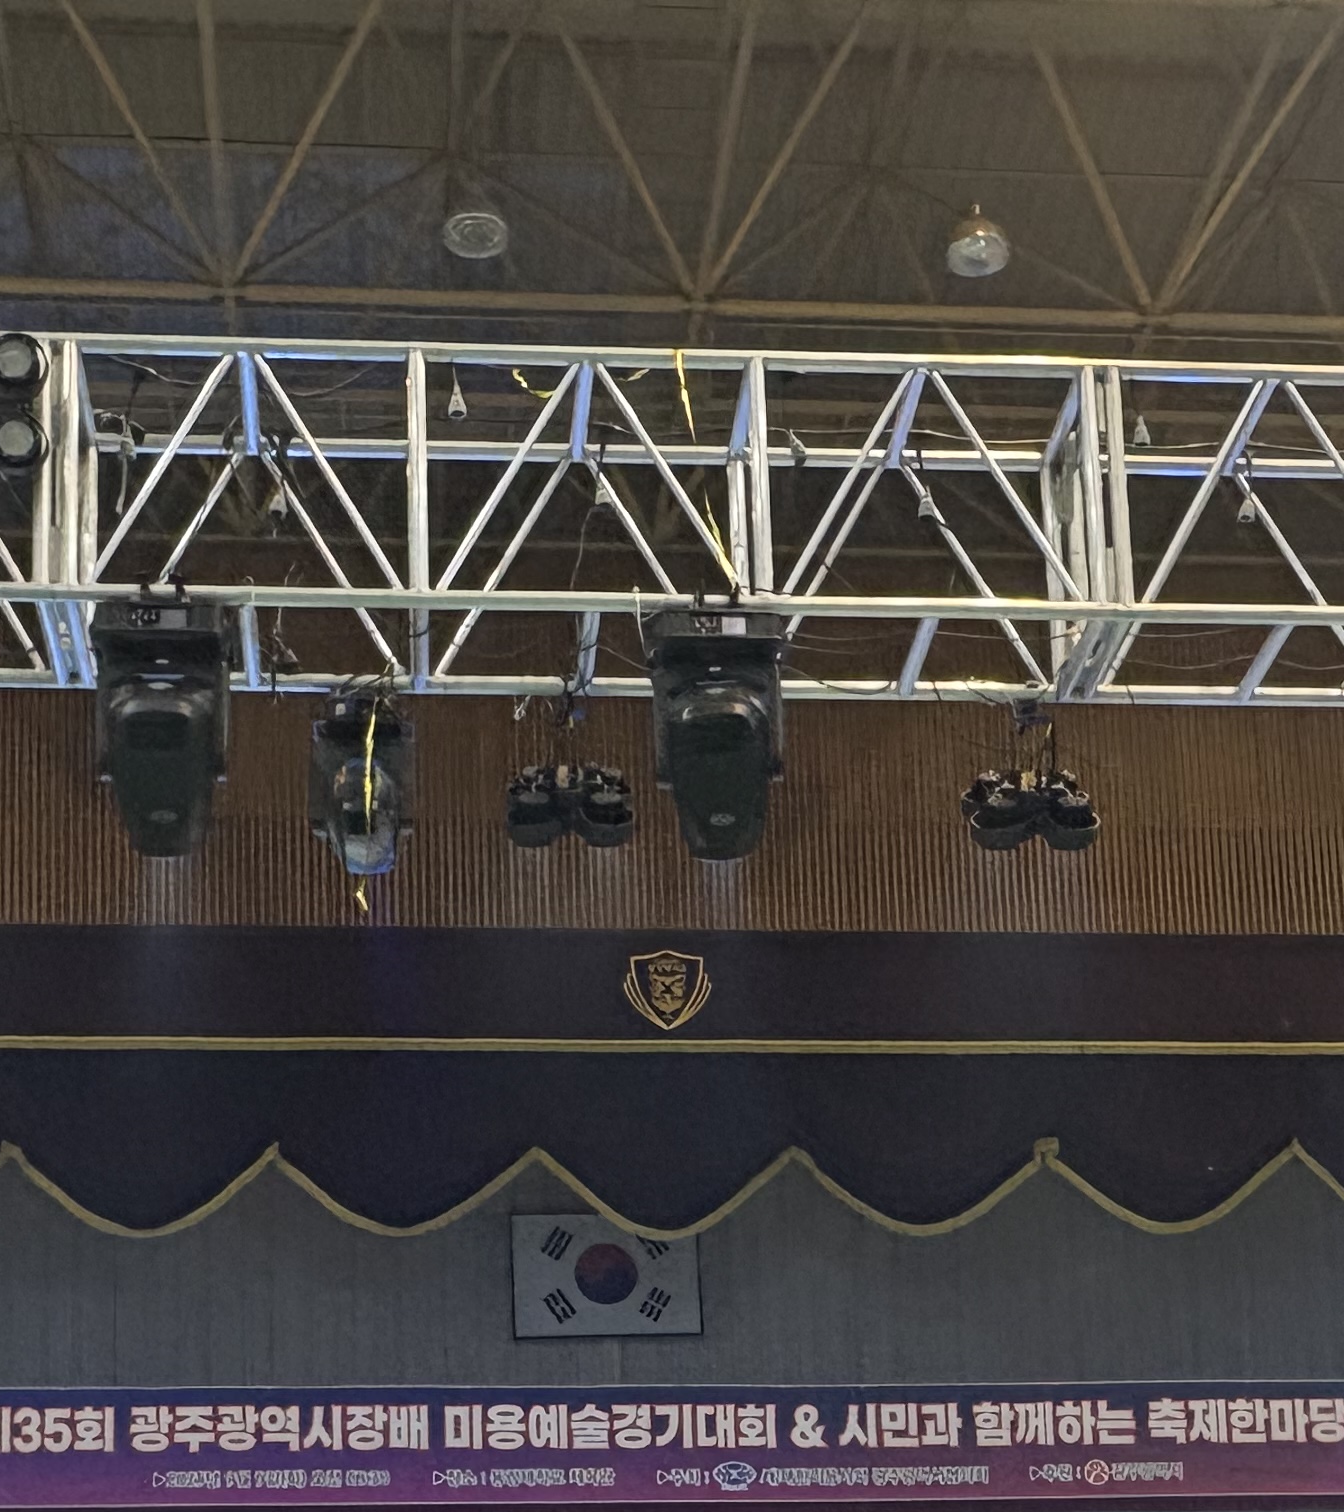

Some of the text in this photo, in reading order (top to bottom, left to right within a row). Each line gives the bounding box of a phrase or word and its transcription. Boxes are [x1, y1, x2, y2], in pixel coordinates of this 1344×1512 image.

[130, 1404, 429, 1453] 광주광역시장배
[445, 1403, 777, 1450] 미용예술경기대회
[790, 1404, 829, 1448] &
[840, 1402, 962, 1449] 시민과
[973, 1400, 1136, 1447] 함께하는
